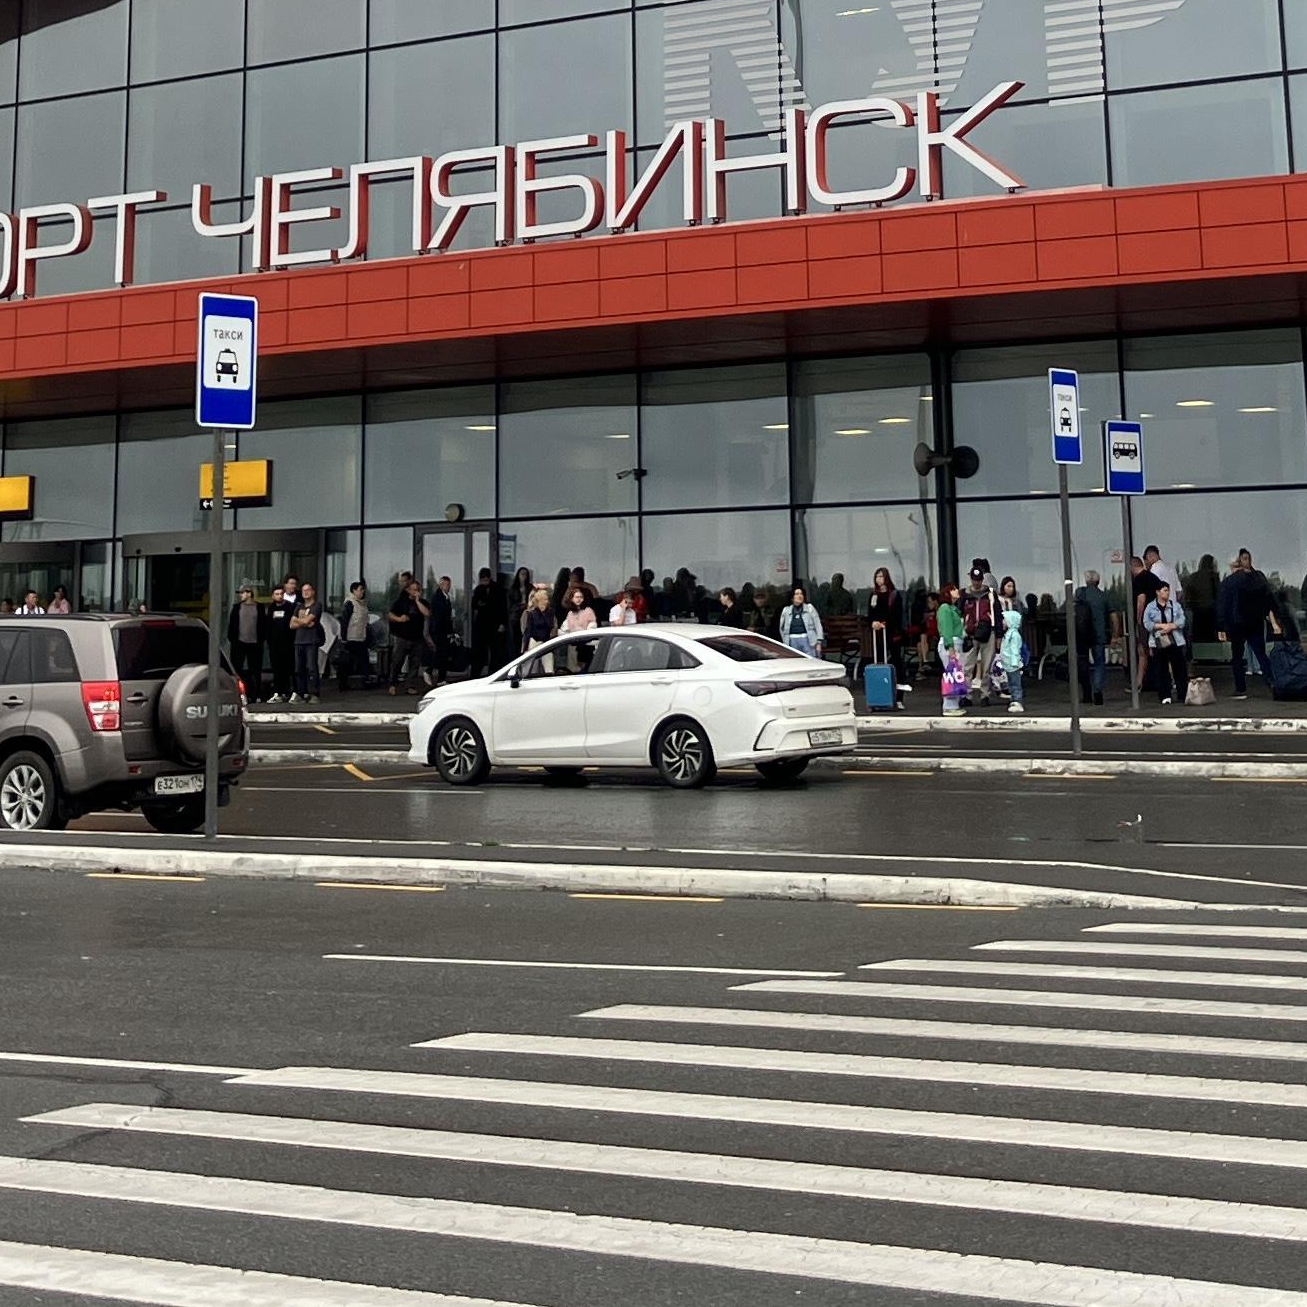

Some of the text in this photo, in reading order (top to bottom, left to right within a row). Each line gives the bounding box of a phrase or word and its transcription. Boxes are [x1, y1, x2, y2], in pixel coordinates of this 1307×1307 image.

[191, 81, 1026, 272] ЧЕЛЯБИНСК
[213, 327, 244, 341] такси
[185, 704, 239, 719] SUUKI
